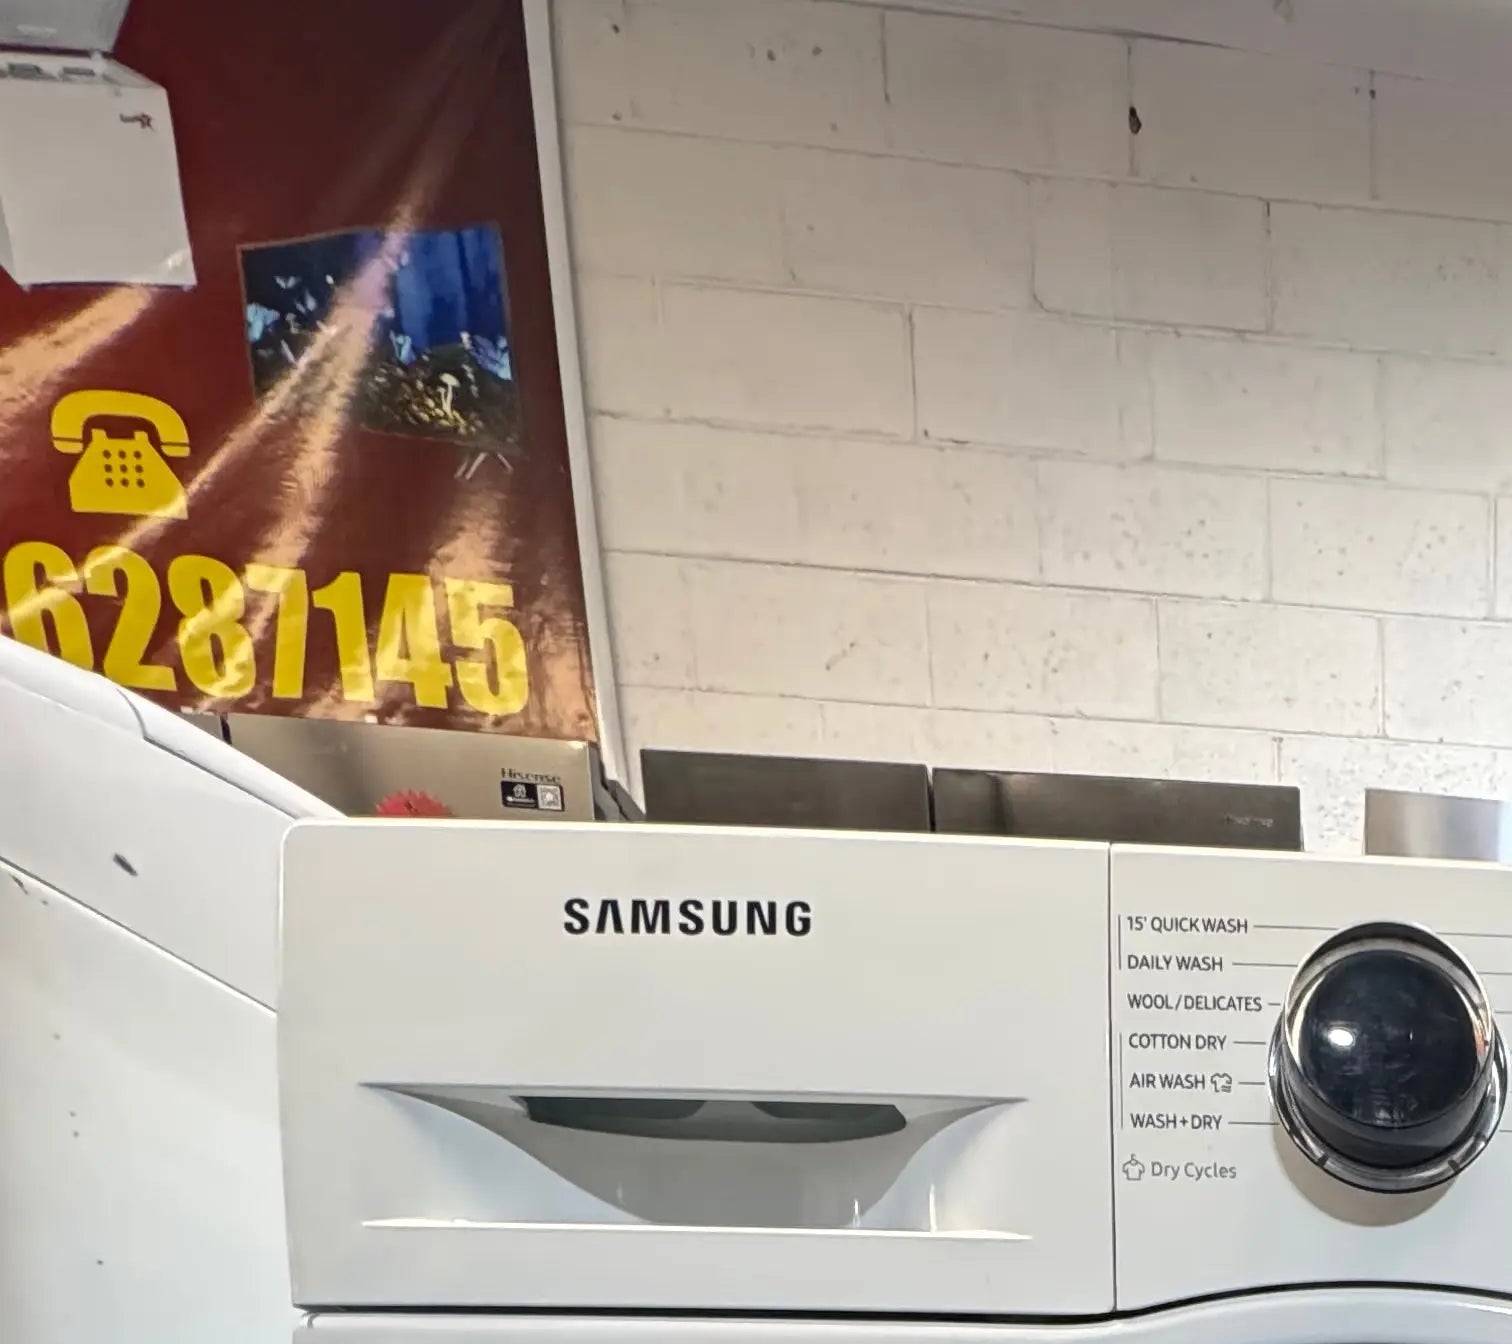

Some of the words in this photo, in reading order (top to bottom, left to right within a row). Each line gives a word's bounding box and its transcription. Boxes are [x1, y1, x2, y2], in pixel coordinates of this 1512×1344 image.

[501, 767, 560, 782] Hisense
[564, 898, 811, 936] SAMSUNG
[1151, 916, 1200, 933] QUICK
[1202, 918, 1248, 934] WASH
[1127, 954, 1172, 970] DAILY
[1176, 955, 1223, 972] WASH
[1128, 1033, 1191, 1049] COTTON
[1195, 1035, 1227, 1050] DRY
[1129, 1072, 1156, 1088] AIR
[1159, 1073, 1205, 1089] WASH
[1151, 1161, 1180, 1181] Dry
[1184, 1162, 1237, 1181] Cycles
